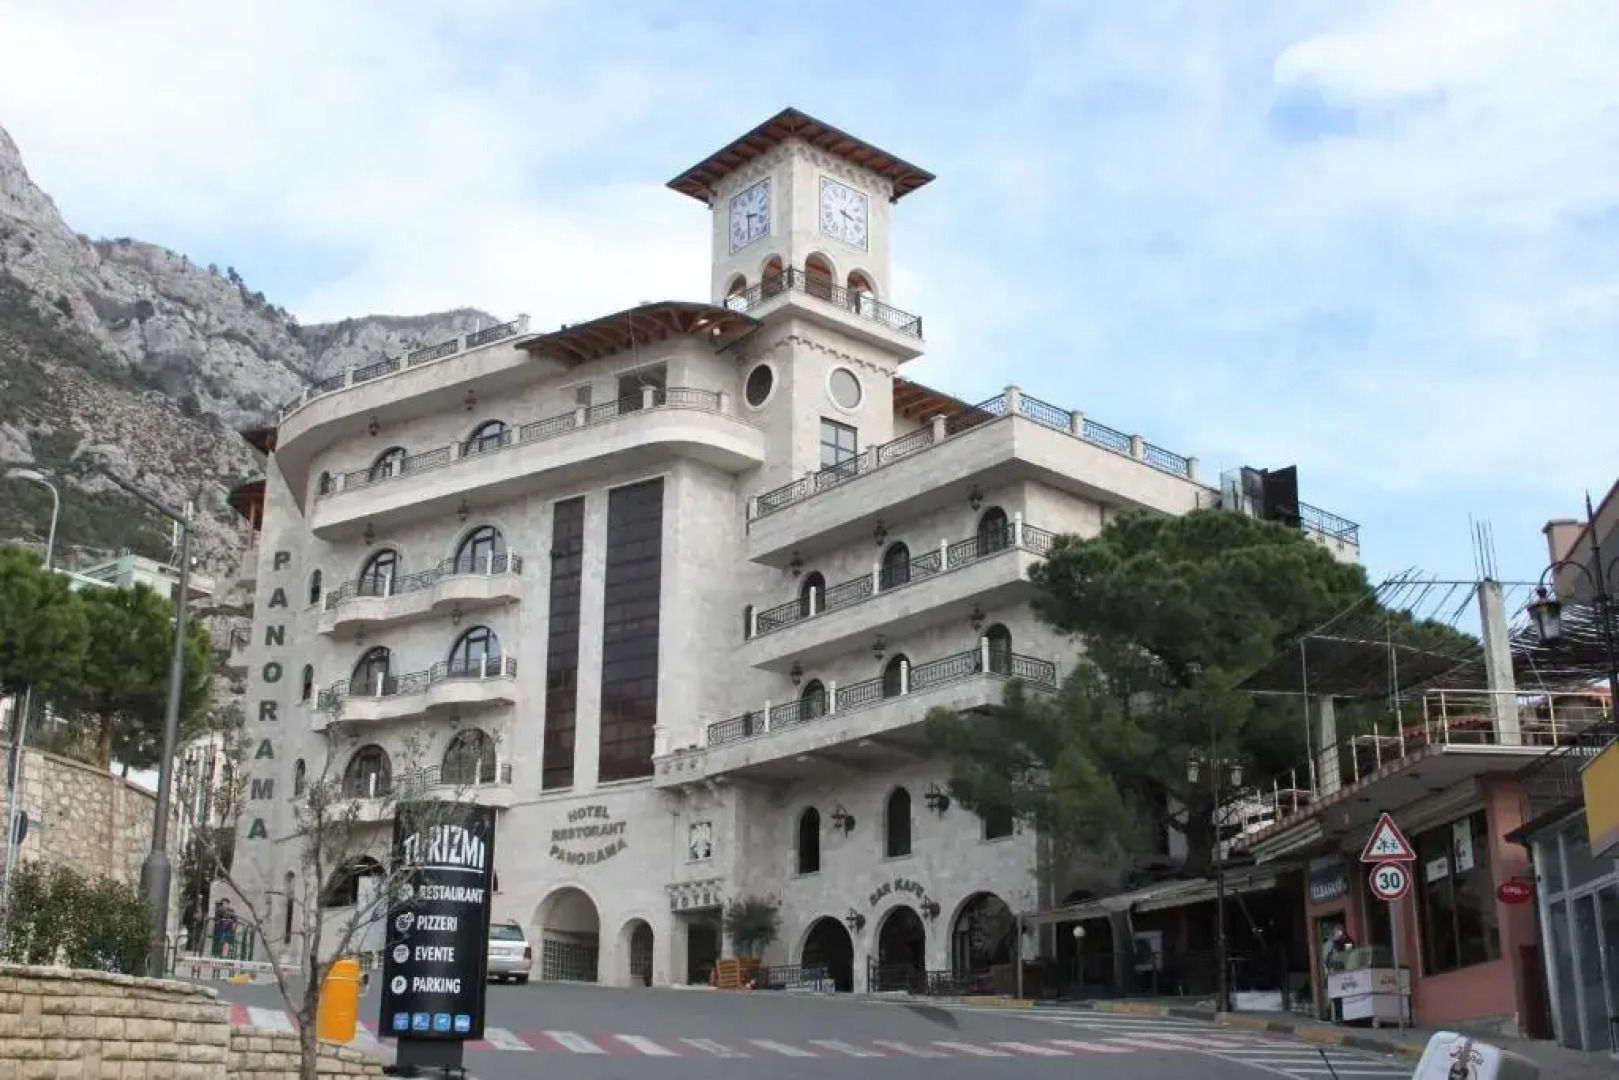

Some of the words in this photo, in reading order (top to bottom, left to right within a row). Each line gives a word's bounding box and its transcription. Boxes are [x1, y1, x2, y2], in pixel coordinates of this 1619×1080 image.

[247, 551, 291, 839] PANORAMA
[568, 805, 610, 823] HOTEL
[1379, 872, 1400, 889] 30
[419, 884, 485, 904] RESTAURANT
[416, 914, 458, 932] PIZZERI
[415, 946, 456, 962] EVENTE
[412, 976, 461, 994] PARKING
